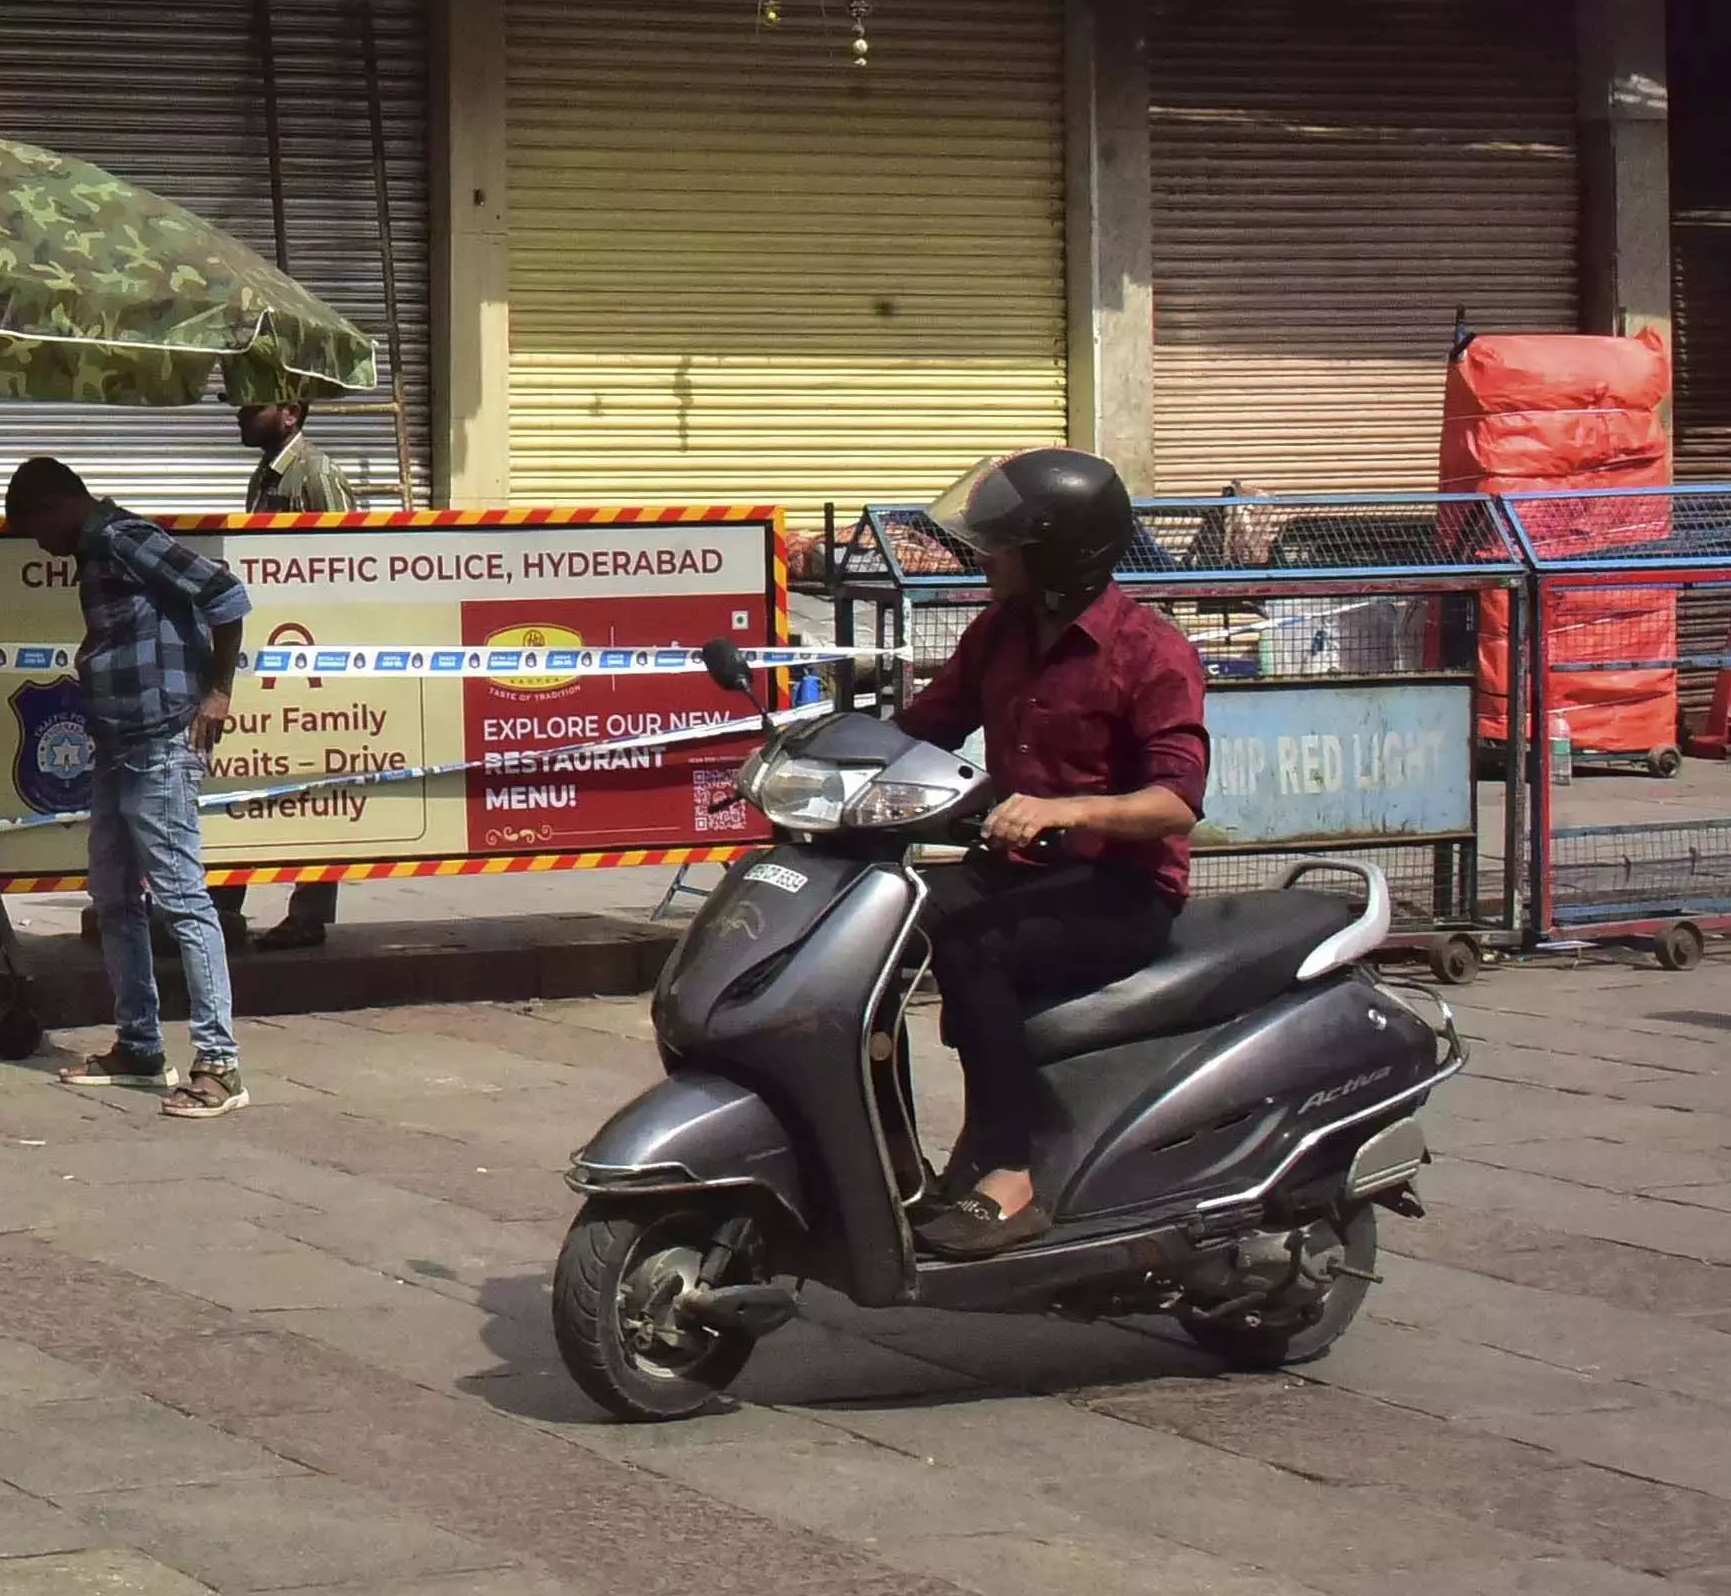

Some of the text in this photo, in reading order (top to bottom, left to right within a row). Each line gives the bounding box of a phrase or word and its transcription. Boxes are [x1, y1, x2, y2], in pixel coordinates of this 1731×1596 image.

[240, 555, 376, 584] TRAFFIC
[388, 551, 515, 583] POLICE,
[522, 548, 723, 577] HYDERABAD
[223, 704, 387, 736] our Family
[483, 711, 732, 742] EXPLORE OUR NEW
[206, 749, 289, 778] waits
[325, 745, 407, 775] Drive
[483, 746, 667, 775] RESTAURANT
[1277, 734, 1343, 795] RED
[1351, 729, 1447, 791] LIGHT
[225, 789, 368, 822] Carefully
[485, 784, 577, 811] MENU!
[1296, 1065, 1394, 1116] Activa
